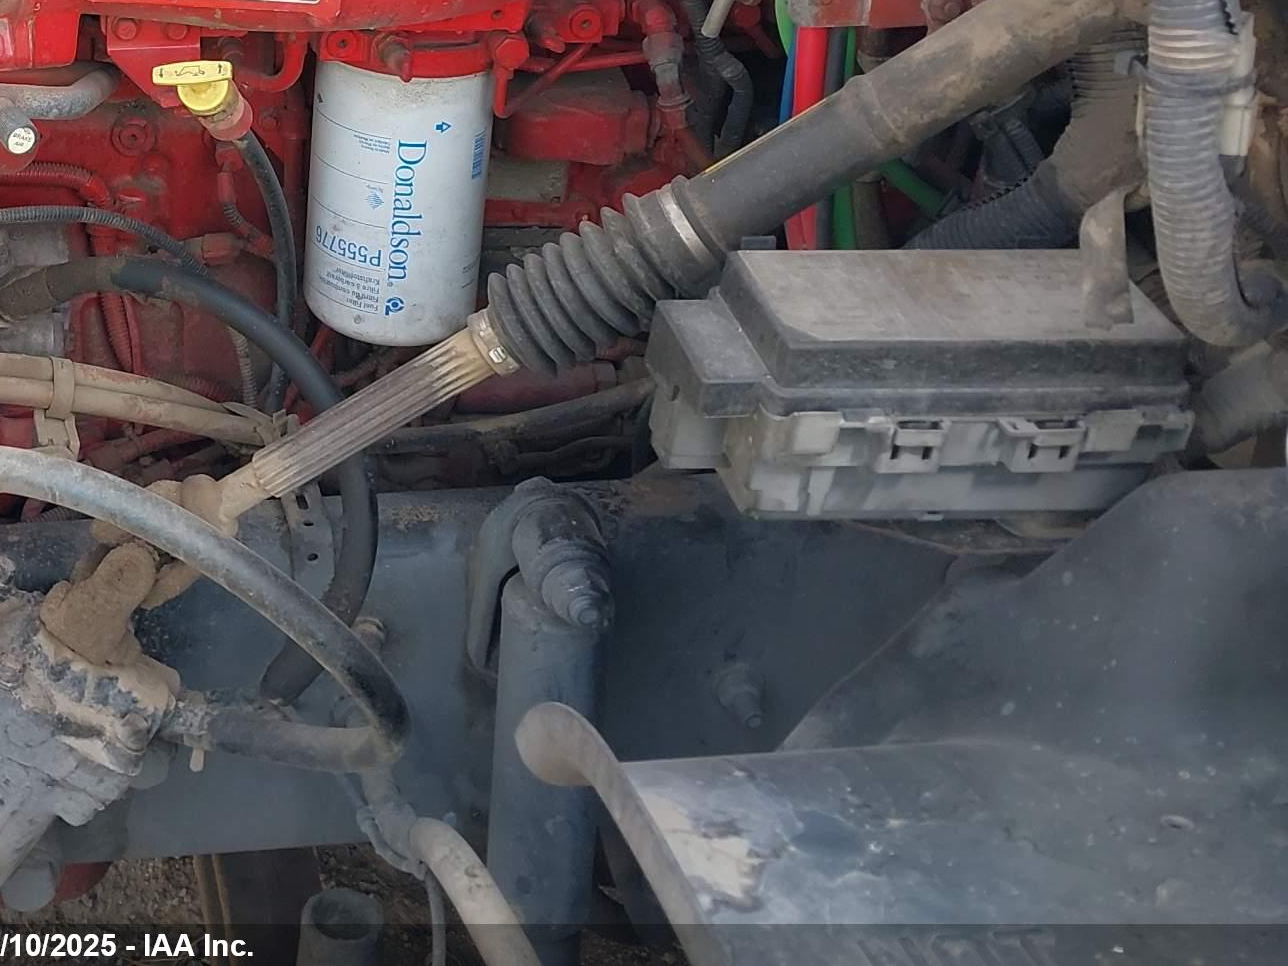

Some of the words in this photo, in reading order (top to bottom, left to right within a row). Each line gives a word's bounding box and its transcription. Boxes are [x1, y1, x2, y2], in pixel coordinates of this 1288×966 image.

[315, 225, 382, 267] P555776
[346, 298, 362, 308] Filter
[363, 302, 378, 311] Fuel
